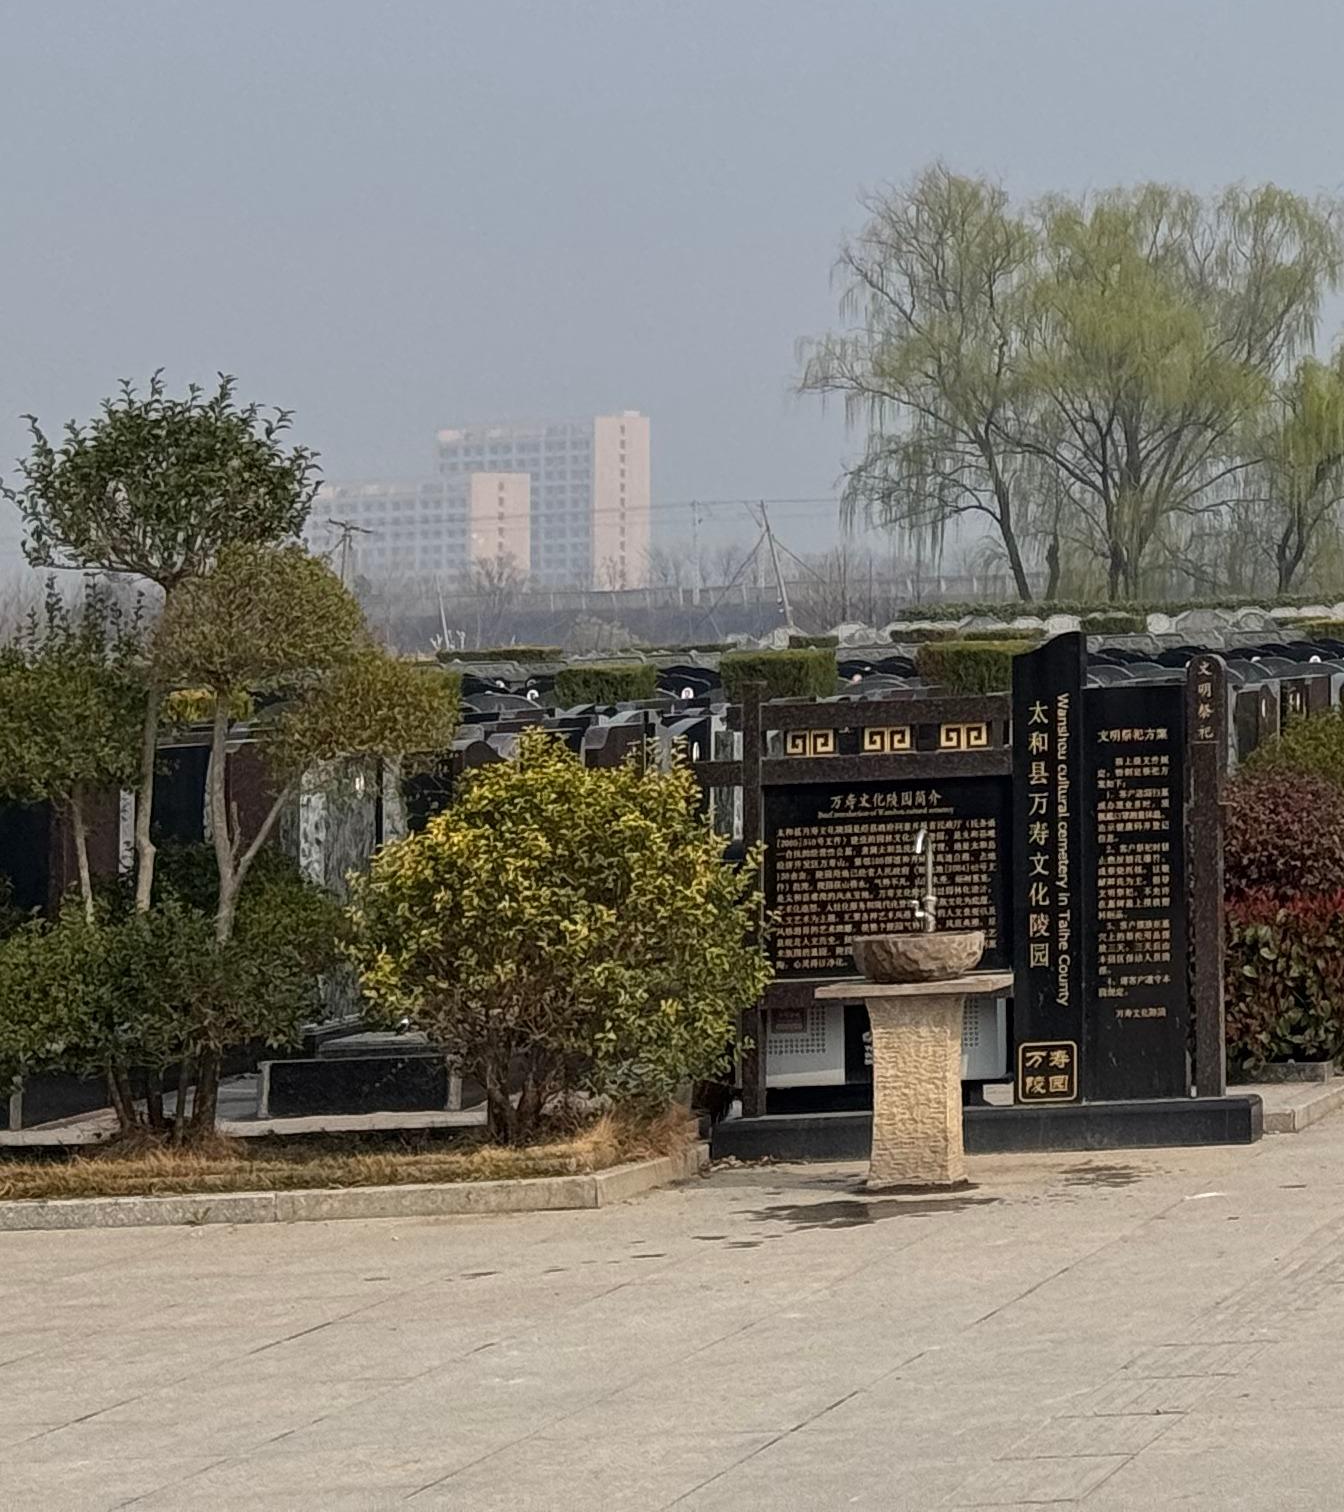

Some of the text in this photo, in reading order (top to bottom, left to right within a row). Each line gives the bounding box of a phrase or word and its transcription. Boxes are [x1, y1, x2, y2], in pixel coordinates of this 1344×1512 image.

[1057, 692, 1070, 760] Wanshou
[1197, 661, 1215, 740] 文明祭祀
[1057, 763, 1070, 817] cultural
[1028, 700, 1050, 968] 太和县万寿文化陵园
[1055, 821, 1069, 888] cemetery
[1058, 909, 1071, 951] Taihe
[1056, 954, 1071, 1006] County
[1025, 1049, 1071, 1069] 万寿
[1025, 1074, 1069, 1094] 陵园
